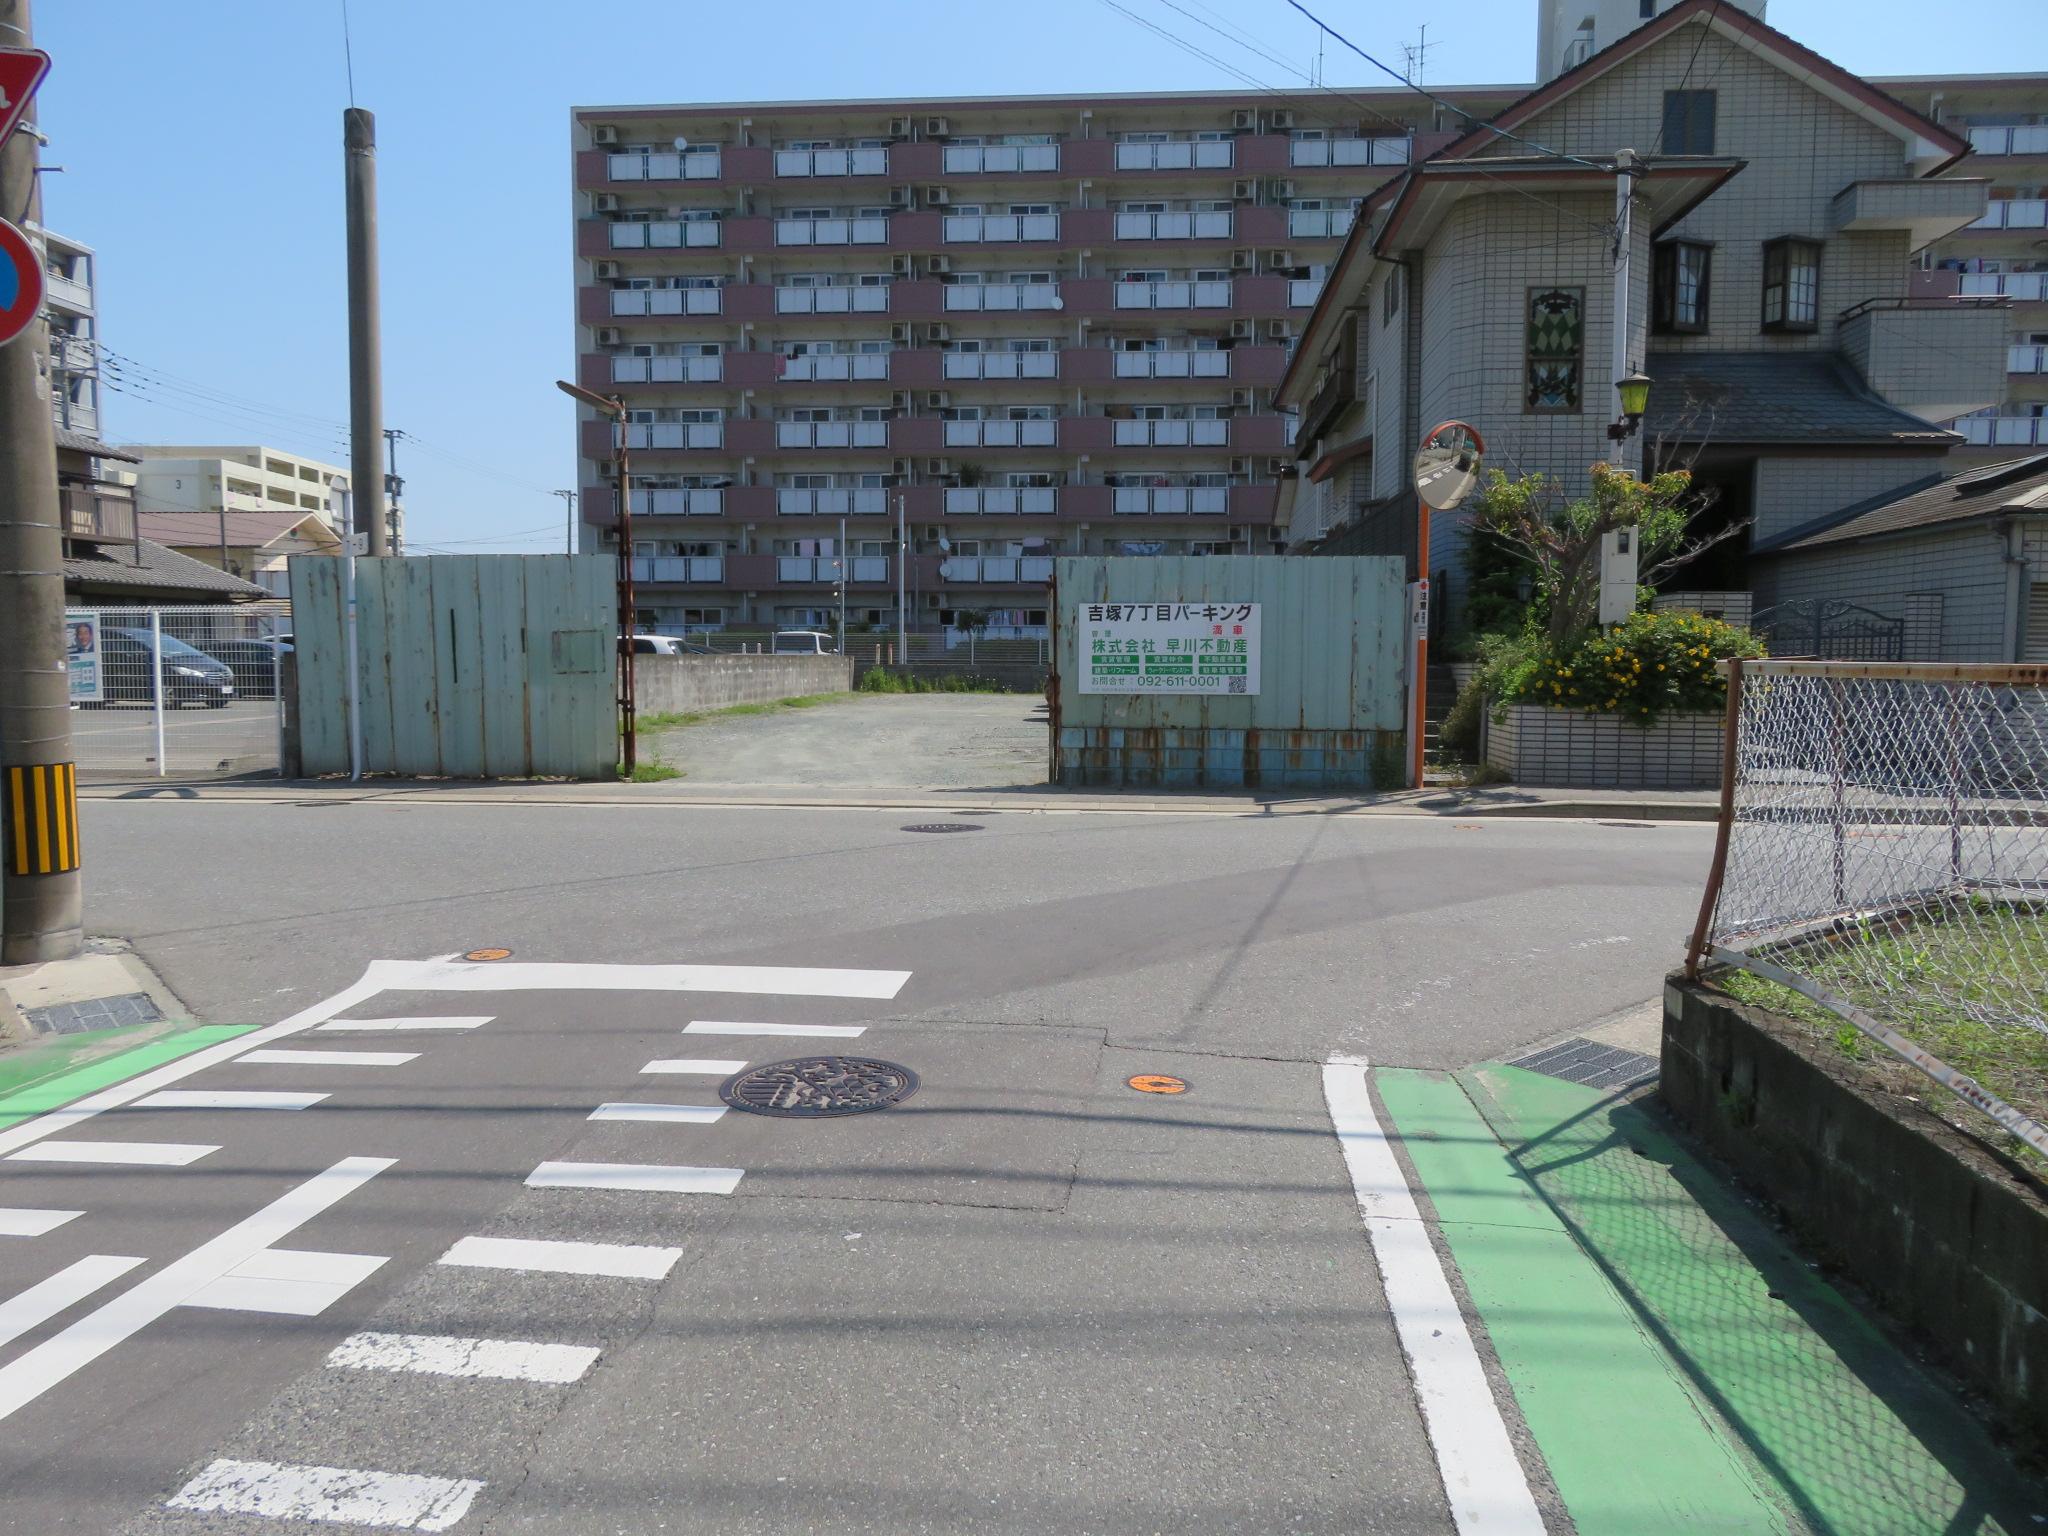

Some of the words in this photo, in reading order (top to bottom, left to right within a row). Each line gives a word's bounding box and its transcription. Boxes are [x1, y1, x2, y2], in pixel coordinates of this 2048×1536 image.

[175, 479, 182, 490] 3
[1088, 604, 1252, 622] 吉塚7丁目パーキング
[1092, 638, 1156, 653] 株式会社
[1166, 638, 1248, 653] 早川不動産
[1137, 676, 1220, 687] 092-611-0001
